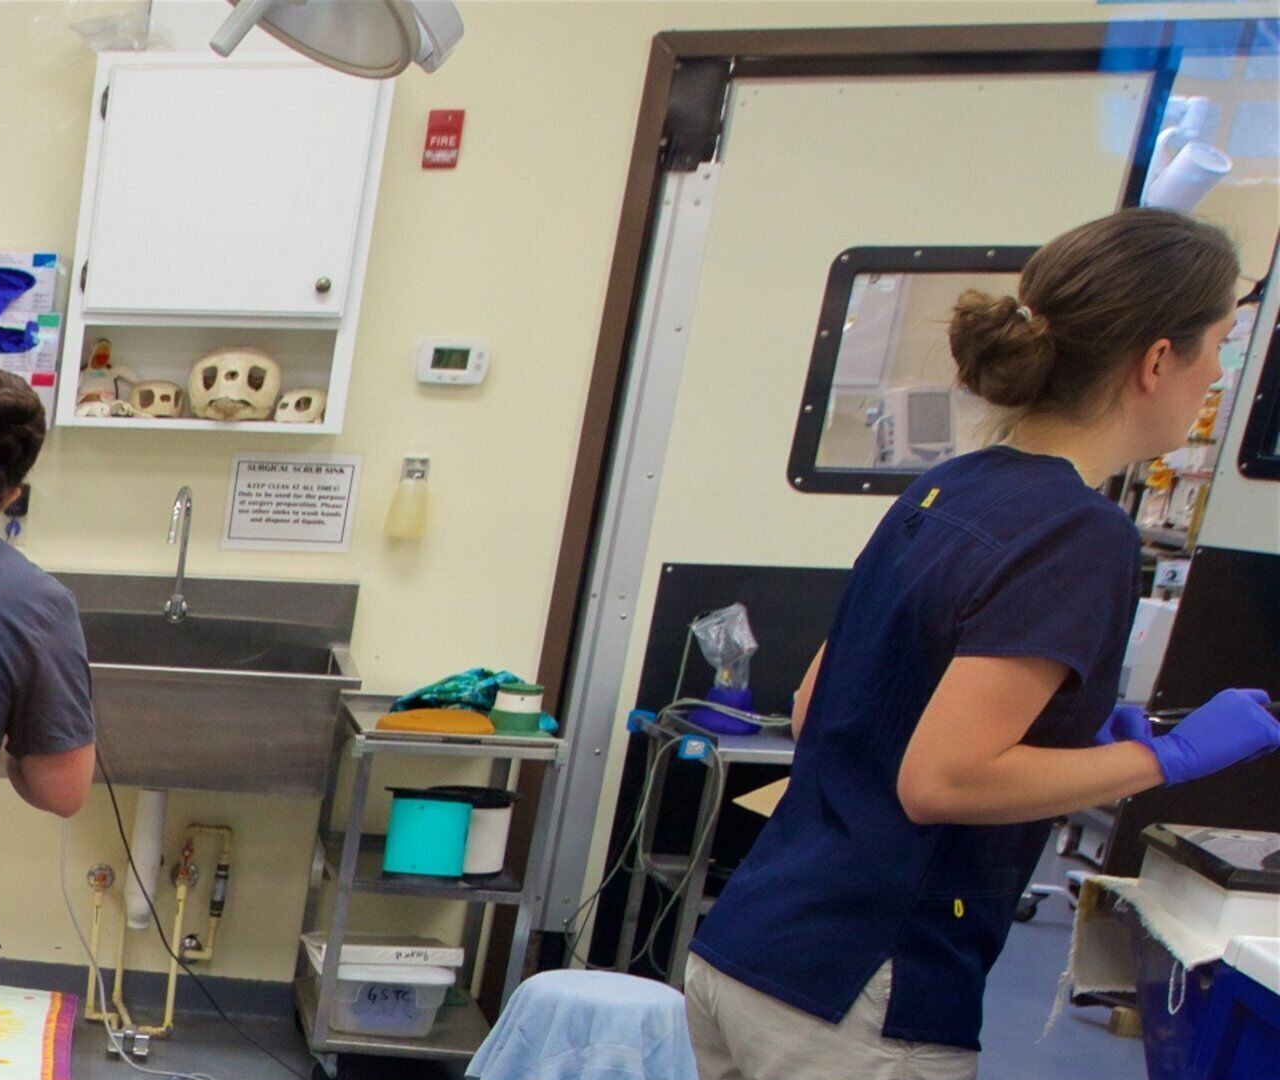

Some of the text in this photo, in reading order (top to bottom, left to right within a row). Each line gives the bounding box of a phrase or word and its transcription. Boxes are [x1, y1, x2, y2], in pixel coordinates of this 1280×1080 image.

[429, 134, 457, 147] FIRE
[247, 463, 345, 475] SURGICAL SCRUB SINK
[321, 510, 342, 518] hands
